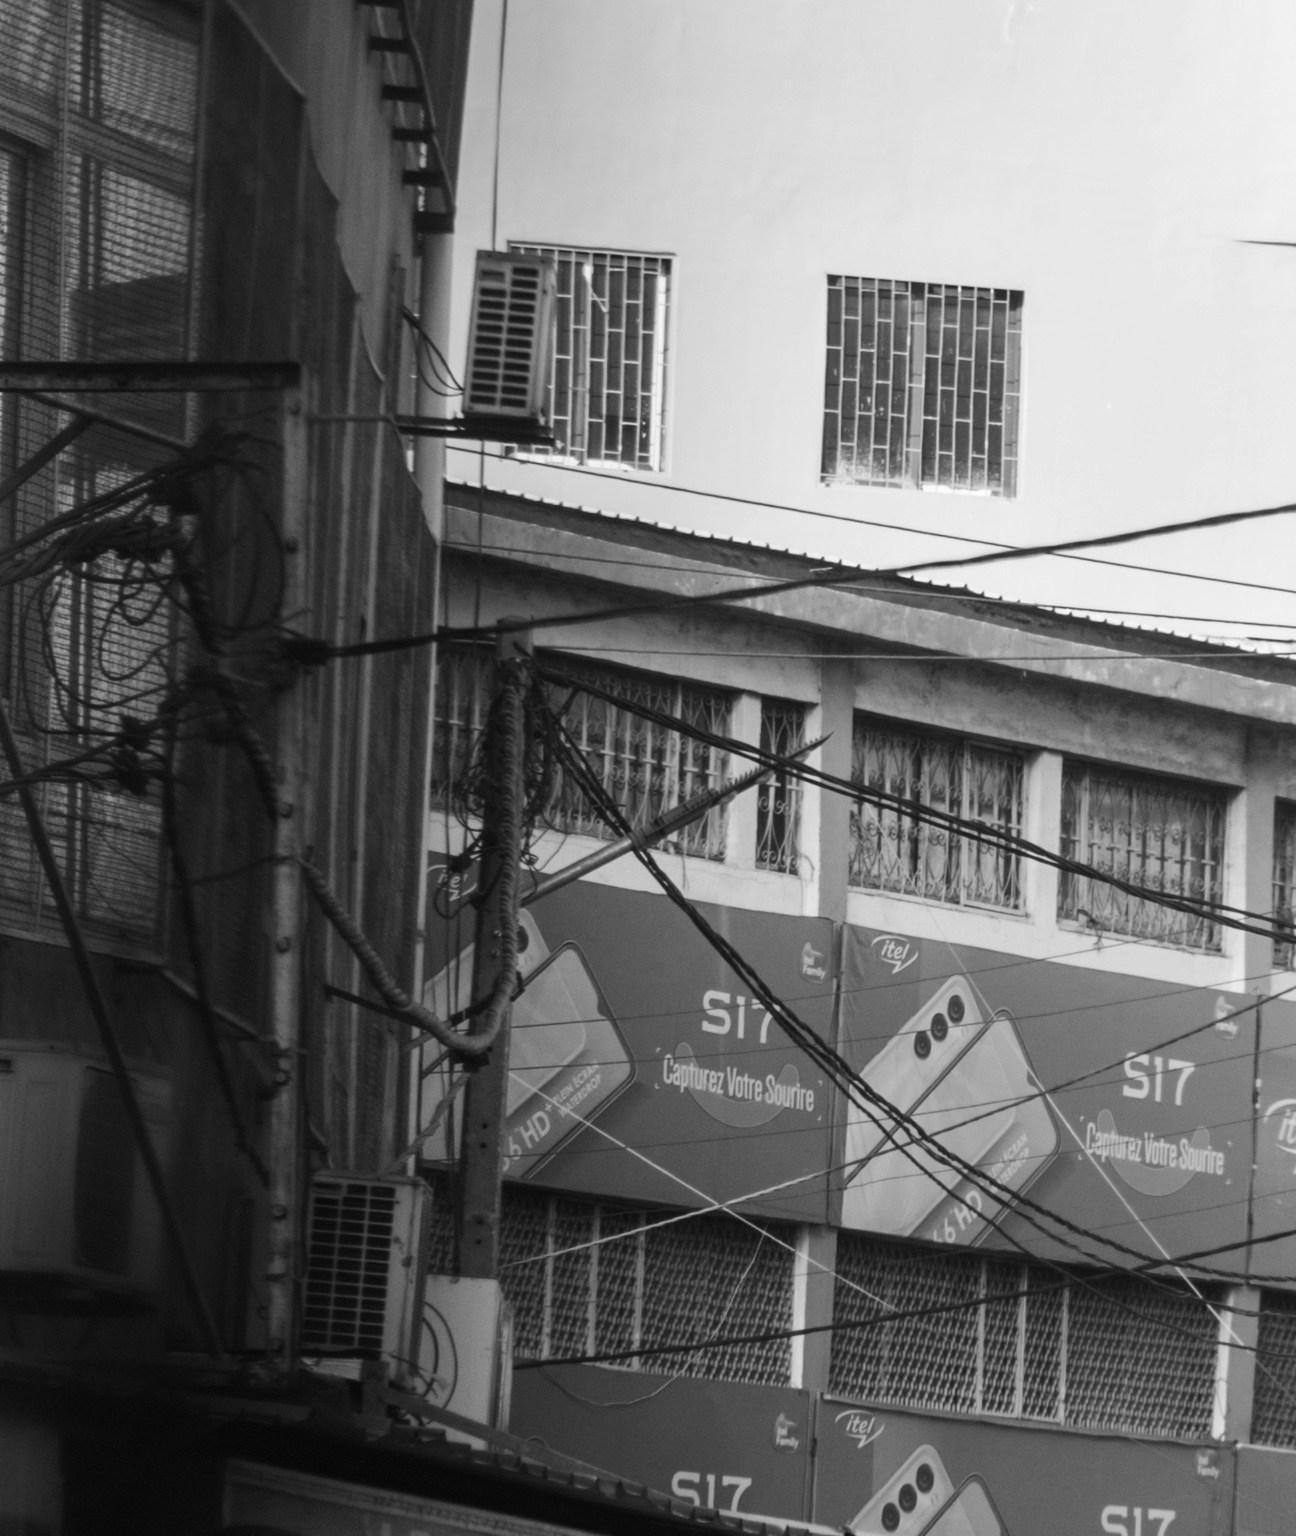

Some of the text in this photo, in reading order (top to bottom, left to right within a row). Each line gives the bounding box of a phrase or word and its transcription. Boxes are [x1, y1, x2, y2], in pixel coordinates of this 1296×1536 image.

[881, 941, 910, 960] itel
[702, 990, 781, 1043] S17
[663, 1054, 814, 1112] Capturez Votre Sourire
[1123, 1052, 1196, 1106] S17
[1086, 1122, 1224, 1175] Capturez Votre Sourire
[845, 1414, 877, 1434] itel
[671, 1470, 752, 1513] S17
